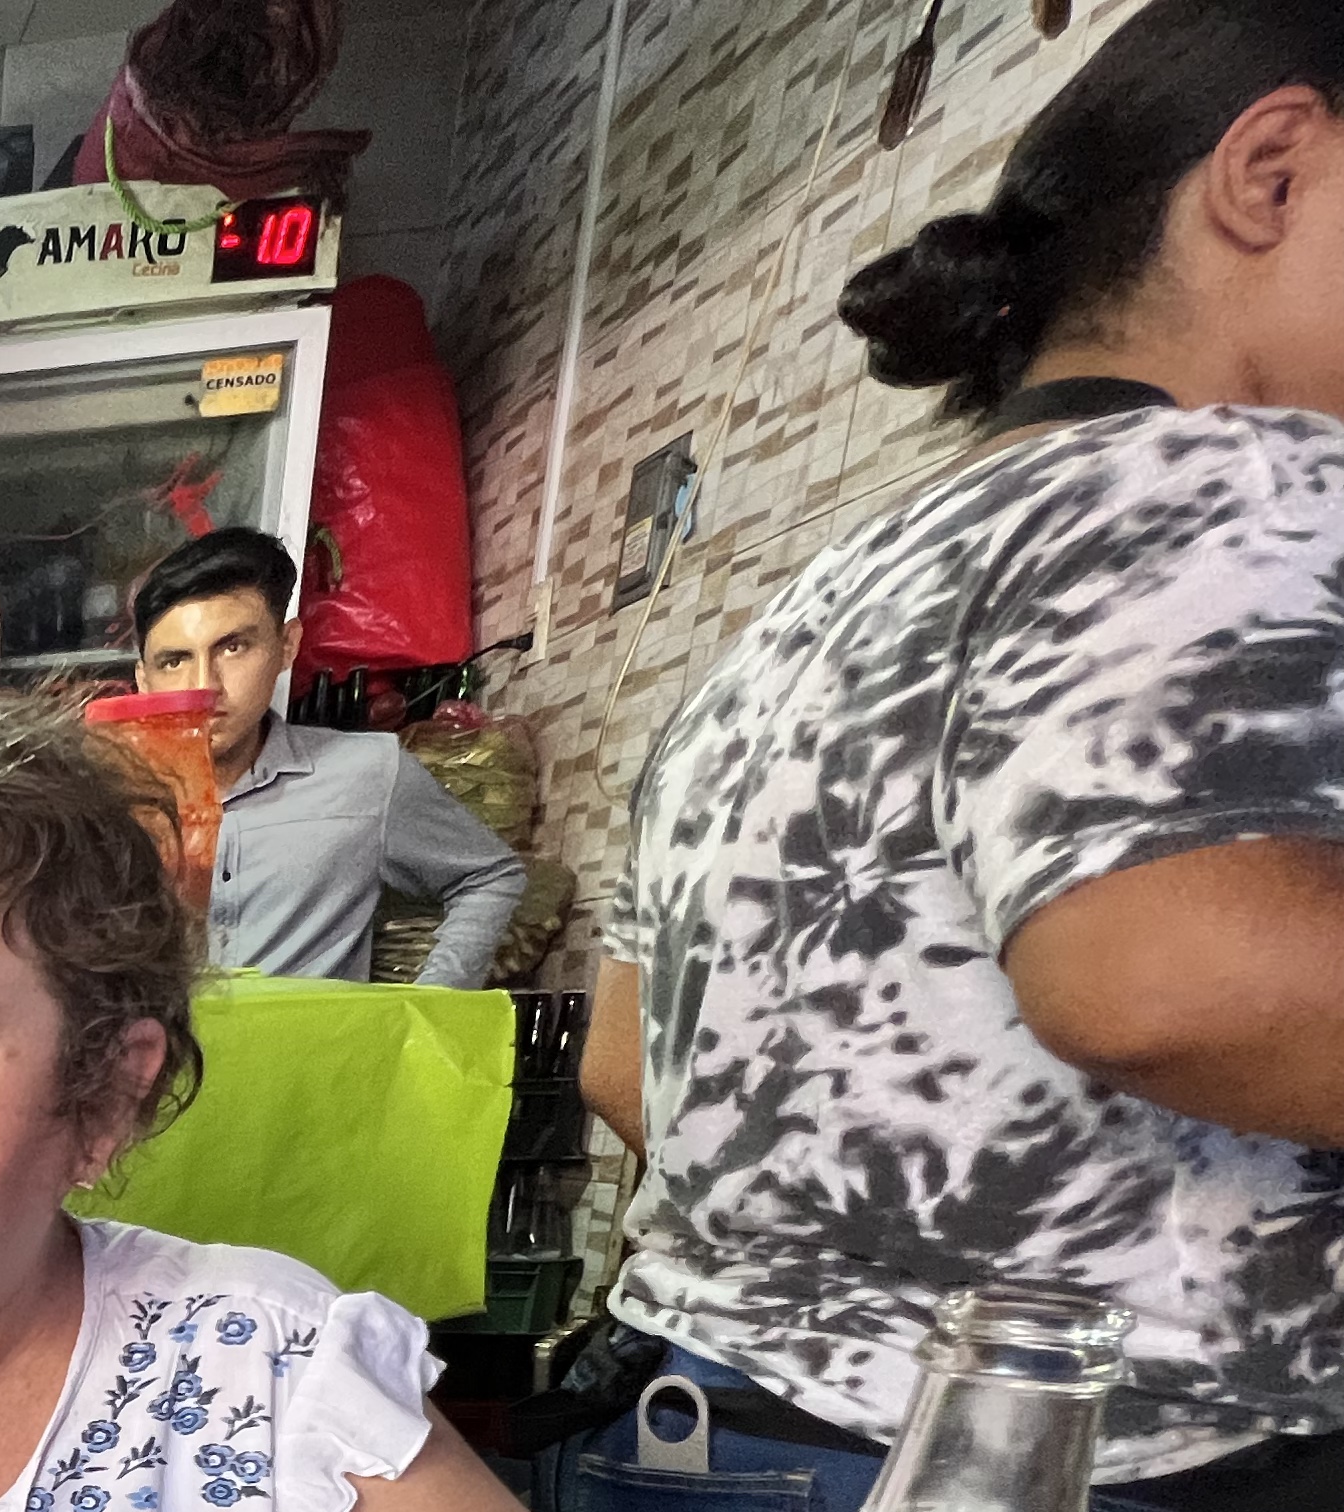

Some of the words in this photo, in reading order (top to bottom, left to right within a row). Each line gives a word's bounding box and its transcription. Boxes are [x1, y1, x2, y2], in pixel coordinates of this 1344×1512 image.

[37, 219, 187, 265] AMARO
[132, 261, 180, 277] Cecina
[206, 373, 276, 390] CENSADO
